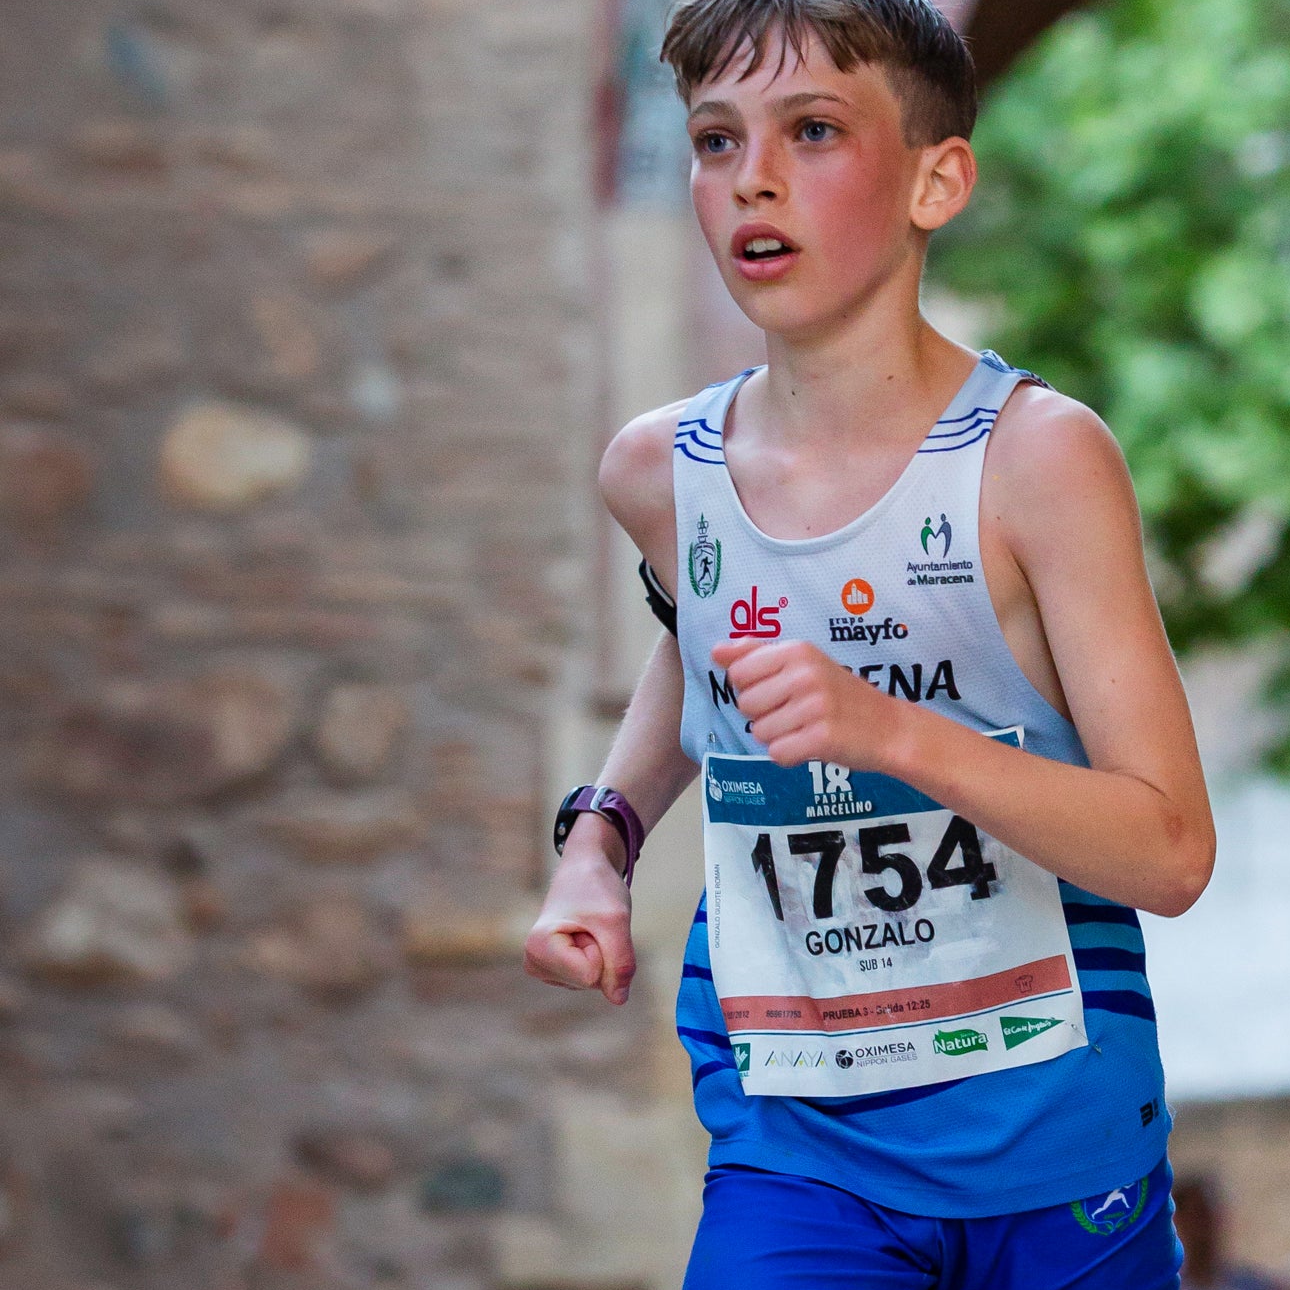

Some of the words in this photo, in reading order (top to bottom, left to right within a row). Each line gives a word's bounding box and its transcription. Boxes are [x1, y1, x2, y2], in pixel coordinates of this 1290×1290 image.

[907, 559, 974, 574] Ayuntamiento
[907, 578, 917, 586] de
[917, 574, 974, 586] Maracena
[829, 616, 864, 627] grupo
[829, 617, 909, 646] mayfo
[808, 761, 852, 795] 18
[721, 780, 764, 795] OXIMESA
[814, 791, 854, 805] PADRE
[806, 800, 873, 818] MARCELINO
[751, 815, 997, 922] 1754
[805, 918, 935, 956] GONZALO
[859, 958, 879, 972] SUB
[881, 957, 893, 969] 14
[823, 1008, 862, 1021] PRUEBA
[906, 999, 931, 1011] 12:25
[855, 1042, 916, 1058] OXIMESA
[933, 1033, 988, 1054] Natura
[764, 1050, 828, 1067] ANAYA
[856, 1057, 888, 1068] NIPPON
[890, 1053, 918, 1063] GASES
